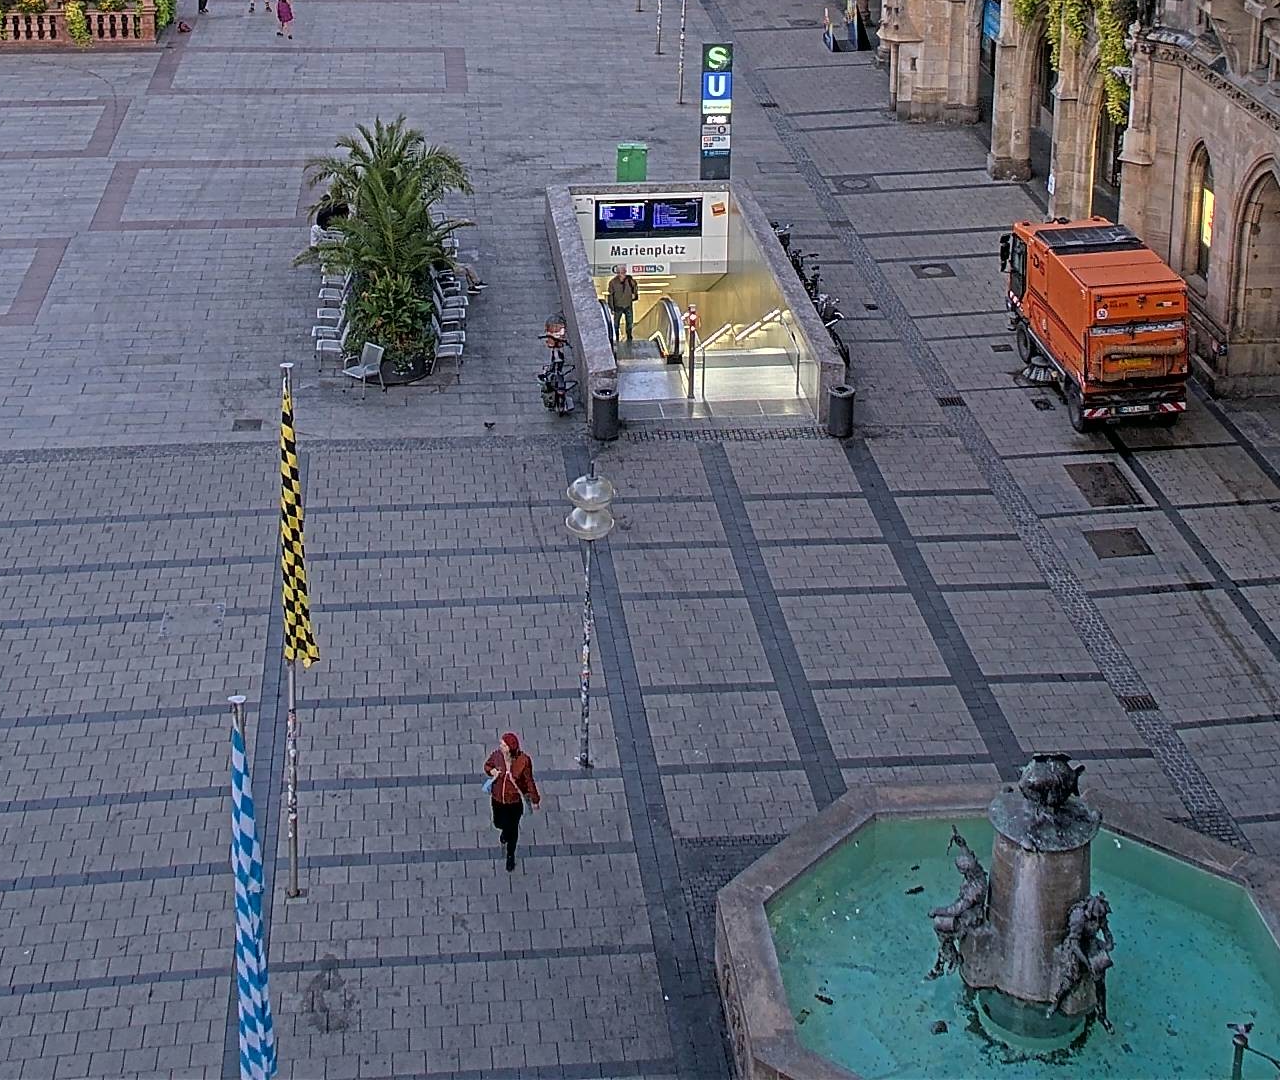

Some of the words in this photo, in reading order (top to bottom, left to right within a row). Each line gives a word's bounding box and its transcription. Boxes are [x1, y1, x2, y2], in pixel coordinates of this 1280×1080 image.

[708, 46, 728, 69] S
[707, 75, 726, 97] U
[610, 243, 686, 258] Marienplatz
